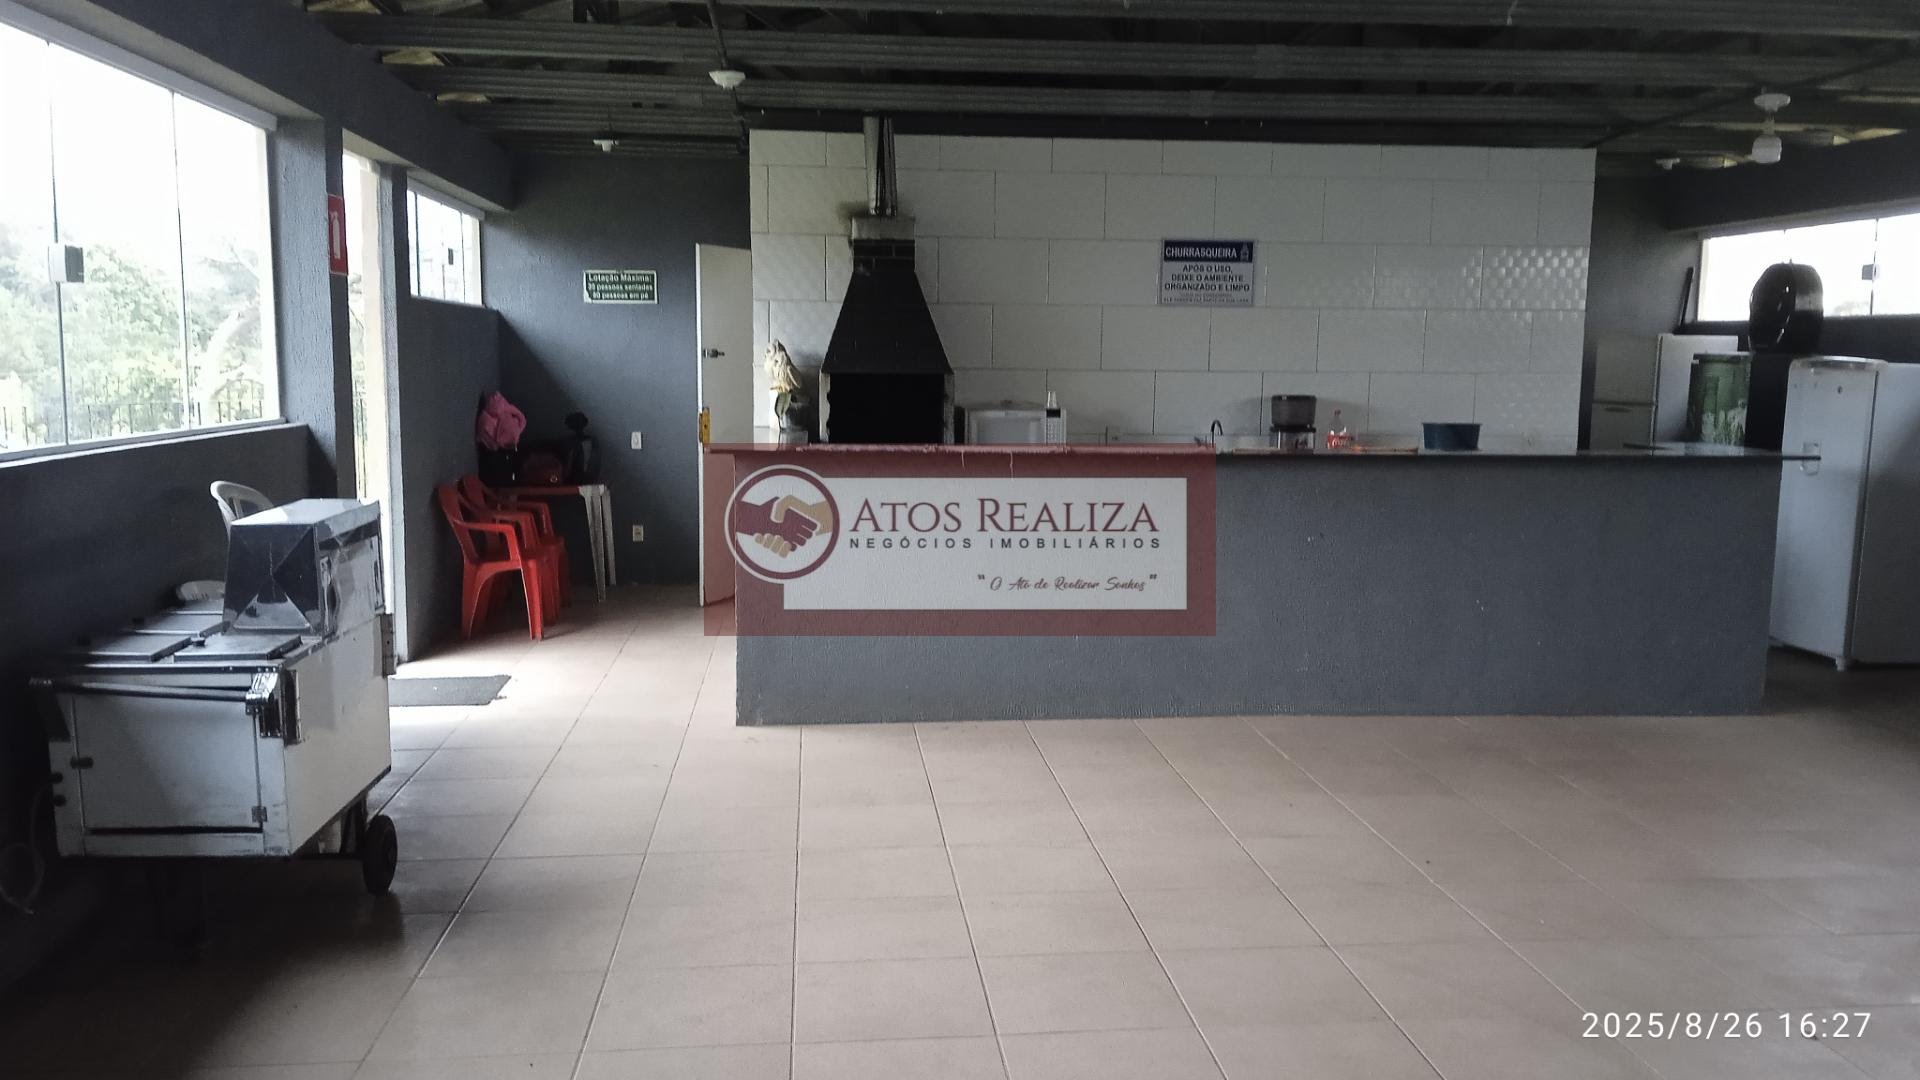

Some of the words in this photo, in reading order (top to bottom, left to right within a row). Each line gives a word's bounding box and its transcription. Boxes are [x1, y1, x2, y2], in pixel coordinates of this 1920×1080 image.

[1165, 247, 1237, 258] CHURRASQUEIRA
[588, 273, 619, 283] Lotação
[1203, 274, 1243, 282] AMBIENTE
[596, 283, 624, 292] pessoas
[624, 283, 653, 291] sentadas
[1164, 283, 1216, 291] ORGANIZADO
[1225, 284, 1250, 292] LIMPO
[602, 292, 628, 300] pessoas
